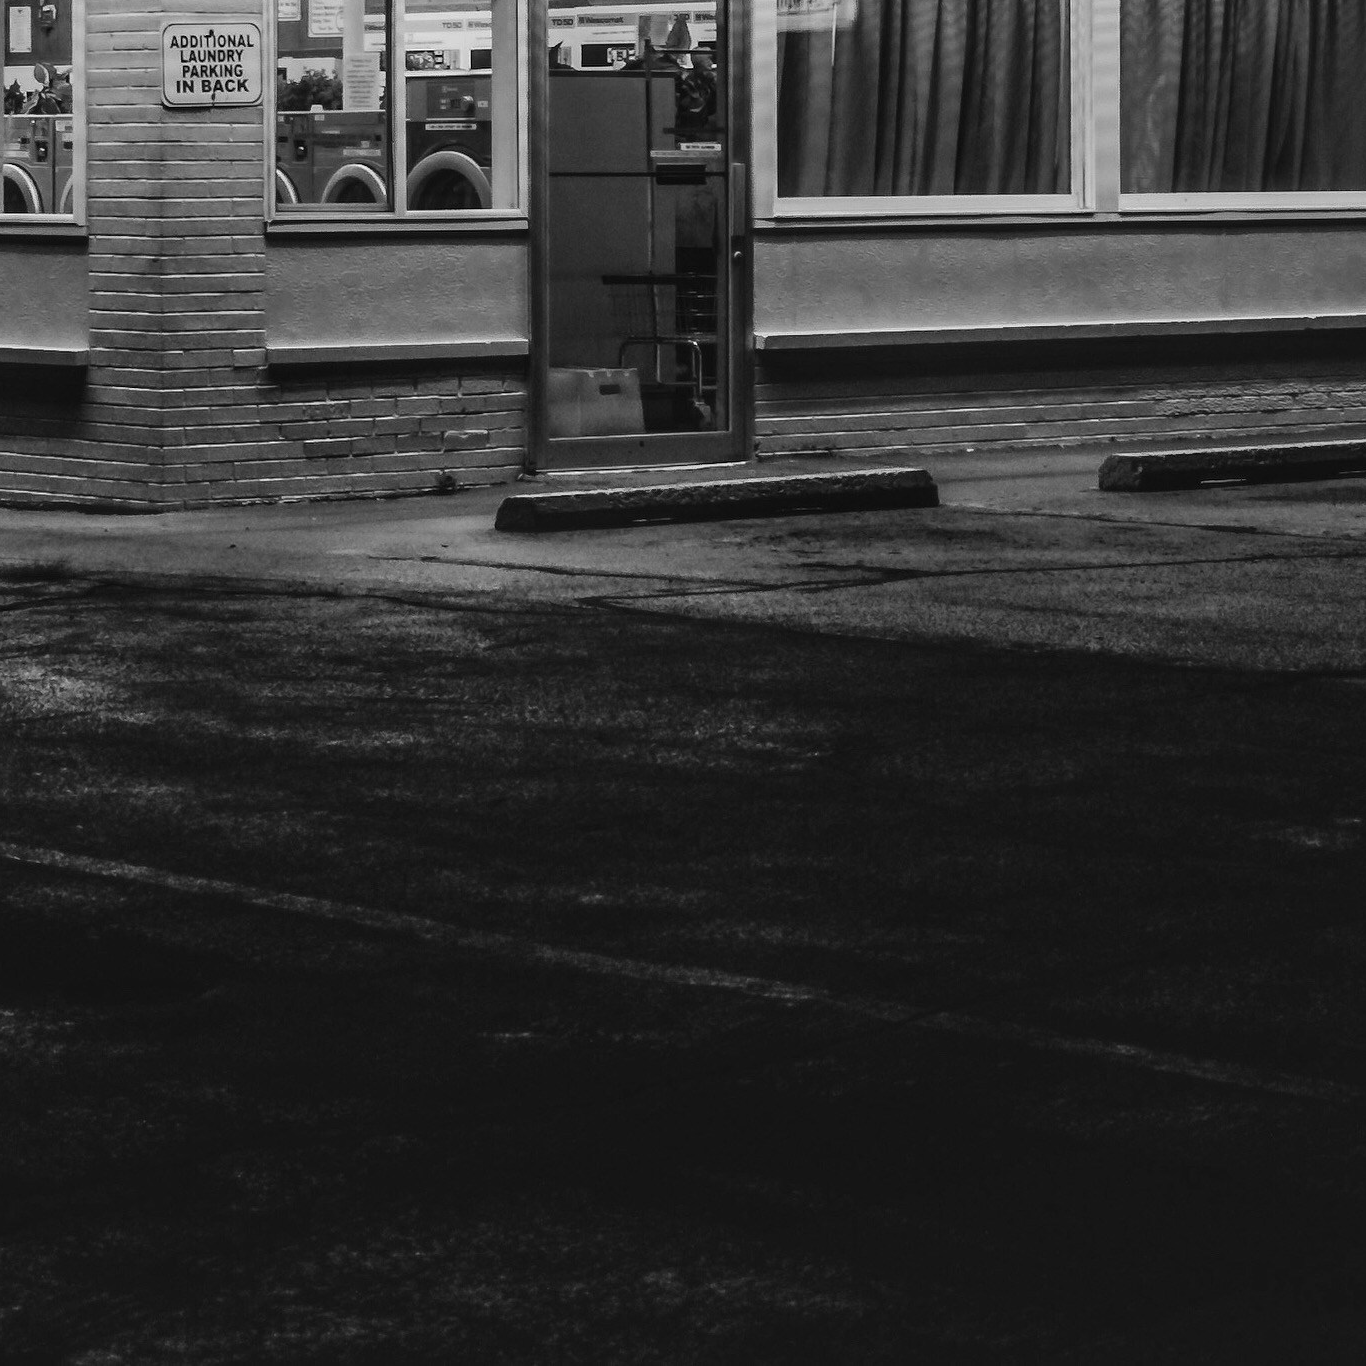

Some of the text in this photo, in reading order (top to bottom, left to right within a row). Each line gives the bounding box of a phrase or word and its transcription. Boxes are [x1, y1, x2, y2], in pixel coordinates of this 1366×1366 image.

[170, 34, 254, 49] ADDITIONAL
[180, 49, 244, 63] LAUNDRY
[182, 64, 244, 78] PARKING
[176, 79, 249, 94] IN BACK
